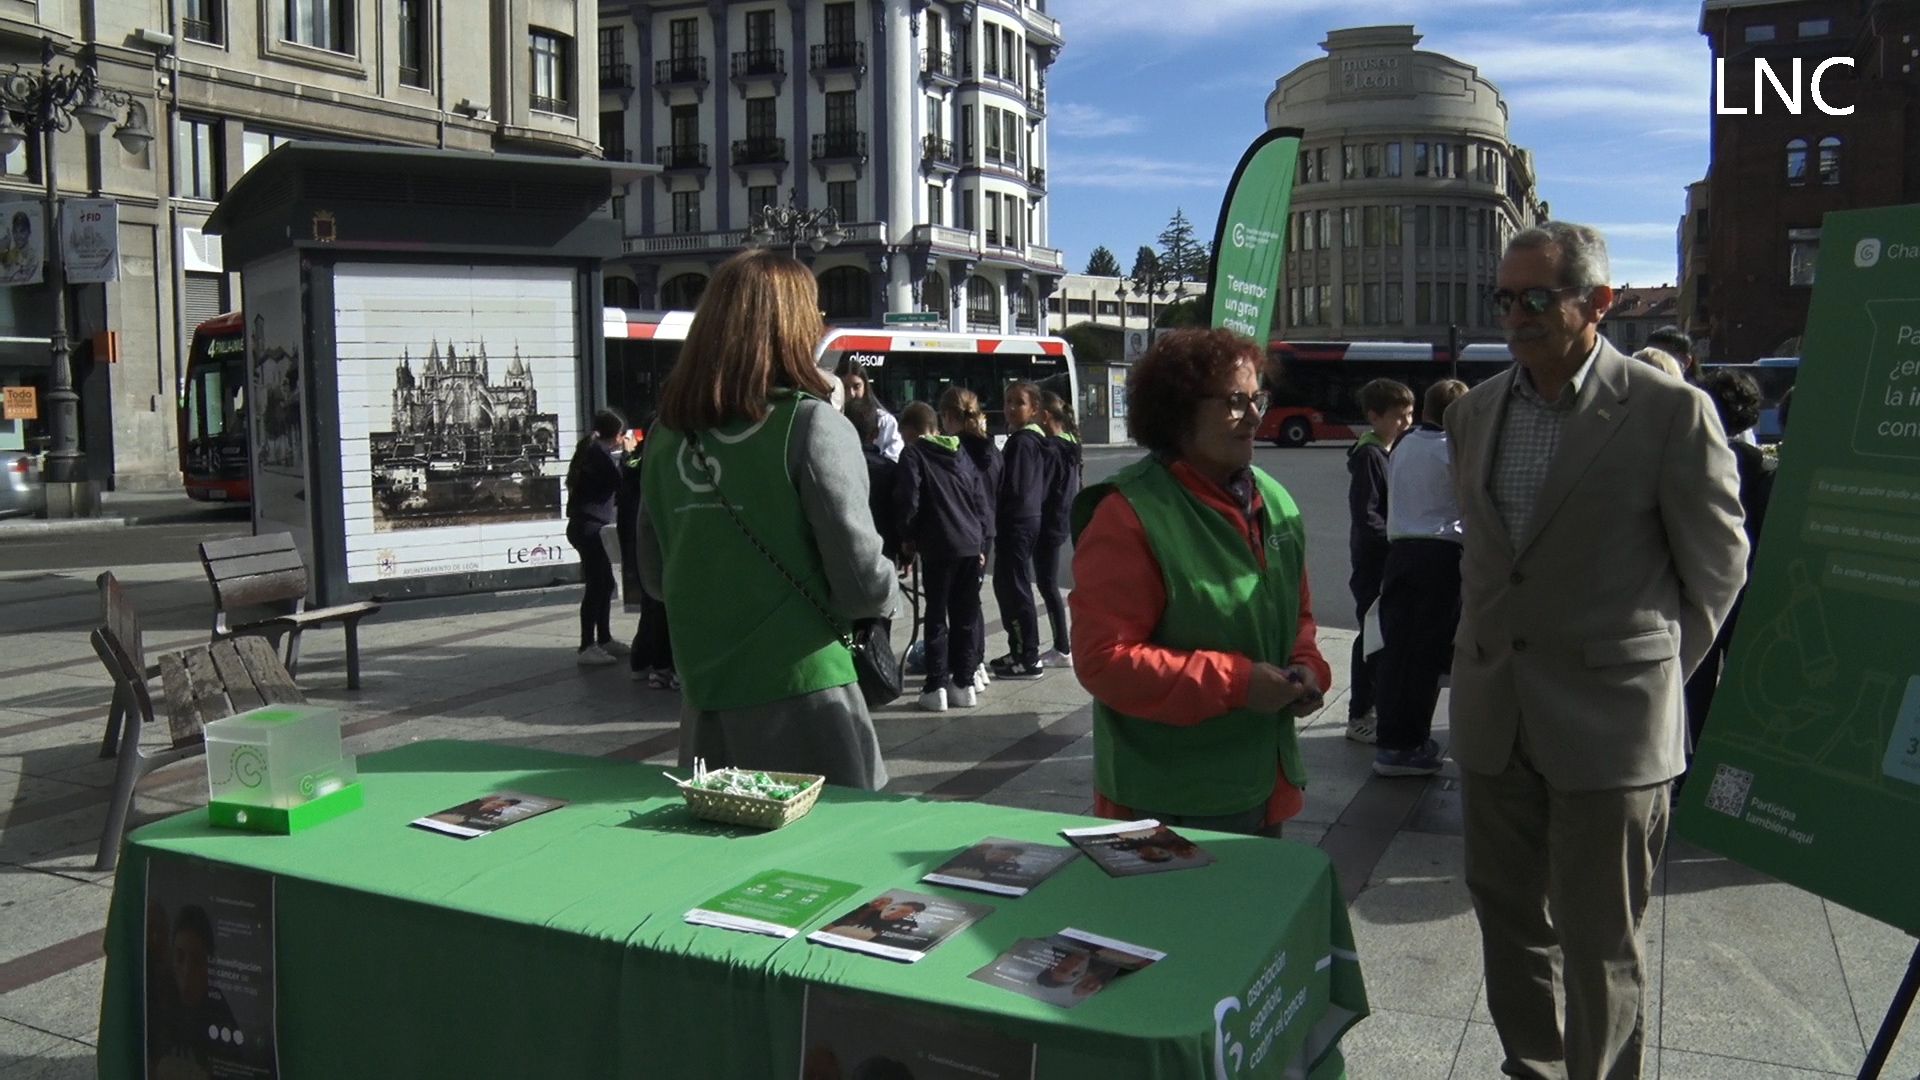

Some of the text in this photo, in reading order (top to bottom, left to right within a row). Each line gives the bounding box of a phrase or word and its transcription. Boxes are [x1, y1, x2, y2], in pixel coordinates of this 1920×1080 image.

[1342, 57, 1398, 72] museo
[1888, 242, 1920, 259] Cha
[208, 339, 215, 358] 4
[6, 389, 32, 399] Todo
[1884, 384, 1903, 406] la
[1878, 421, 1920, 437] con
[403, 564, 452, 575] AYUNTAMIENTO
[453, 563, 461, 572] DE
[1751, 796, 1797, 822] Participa
